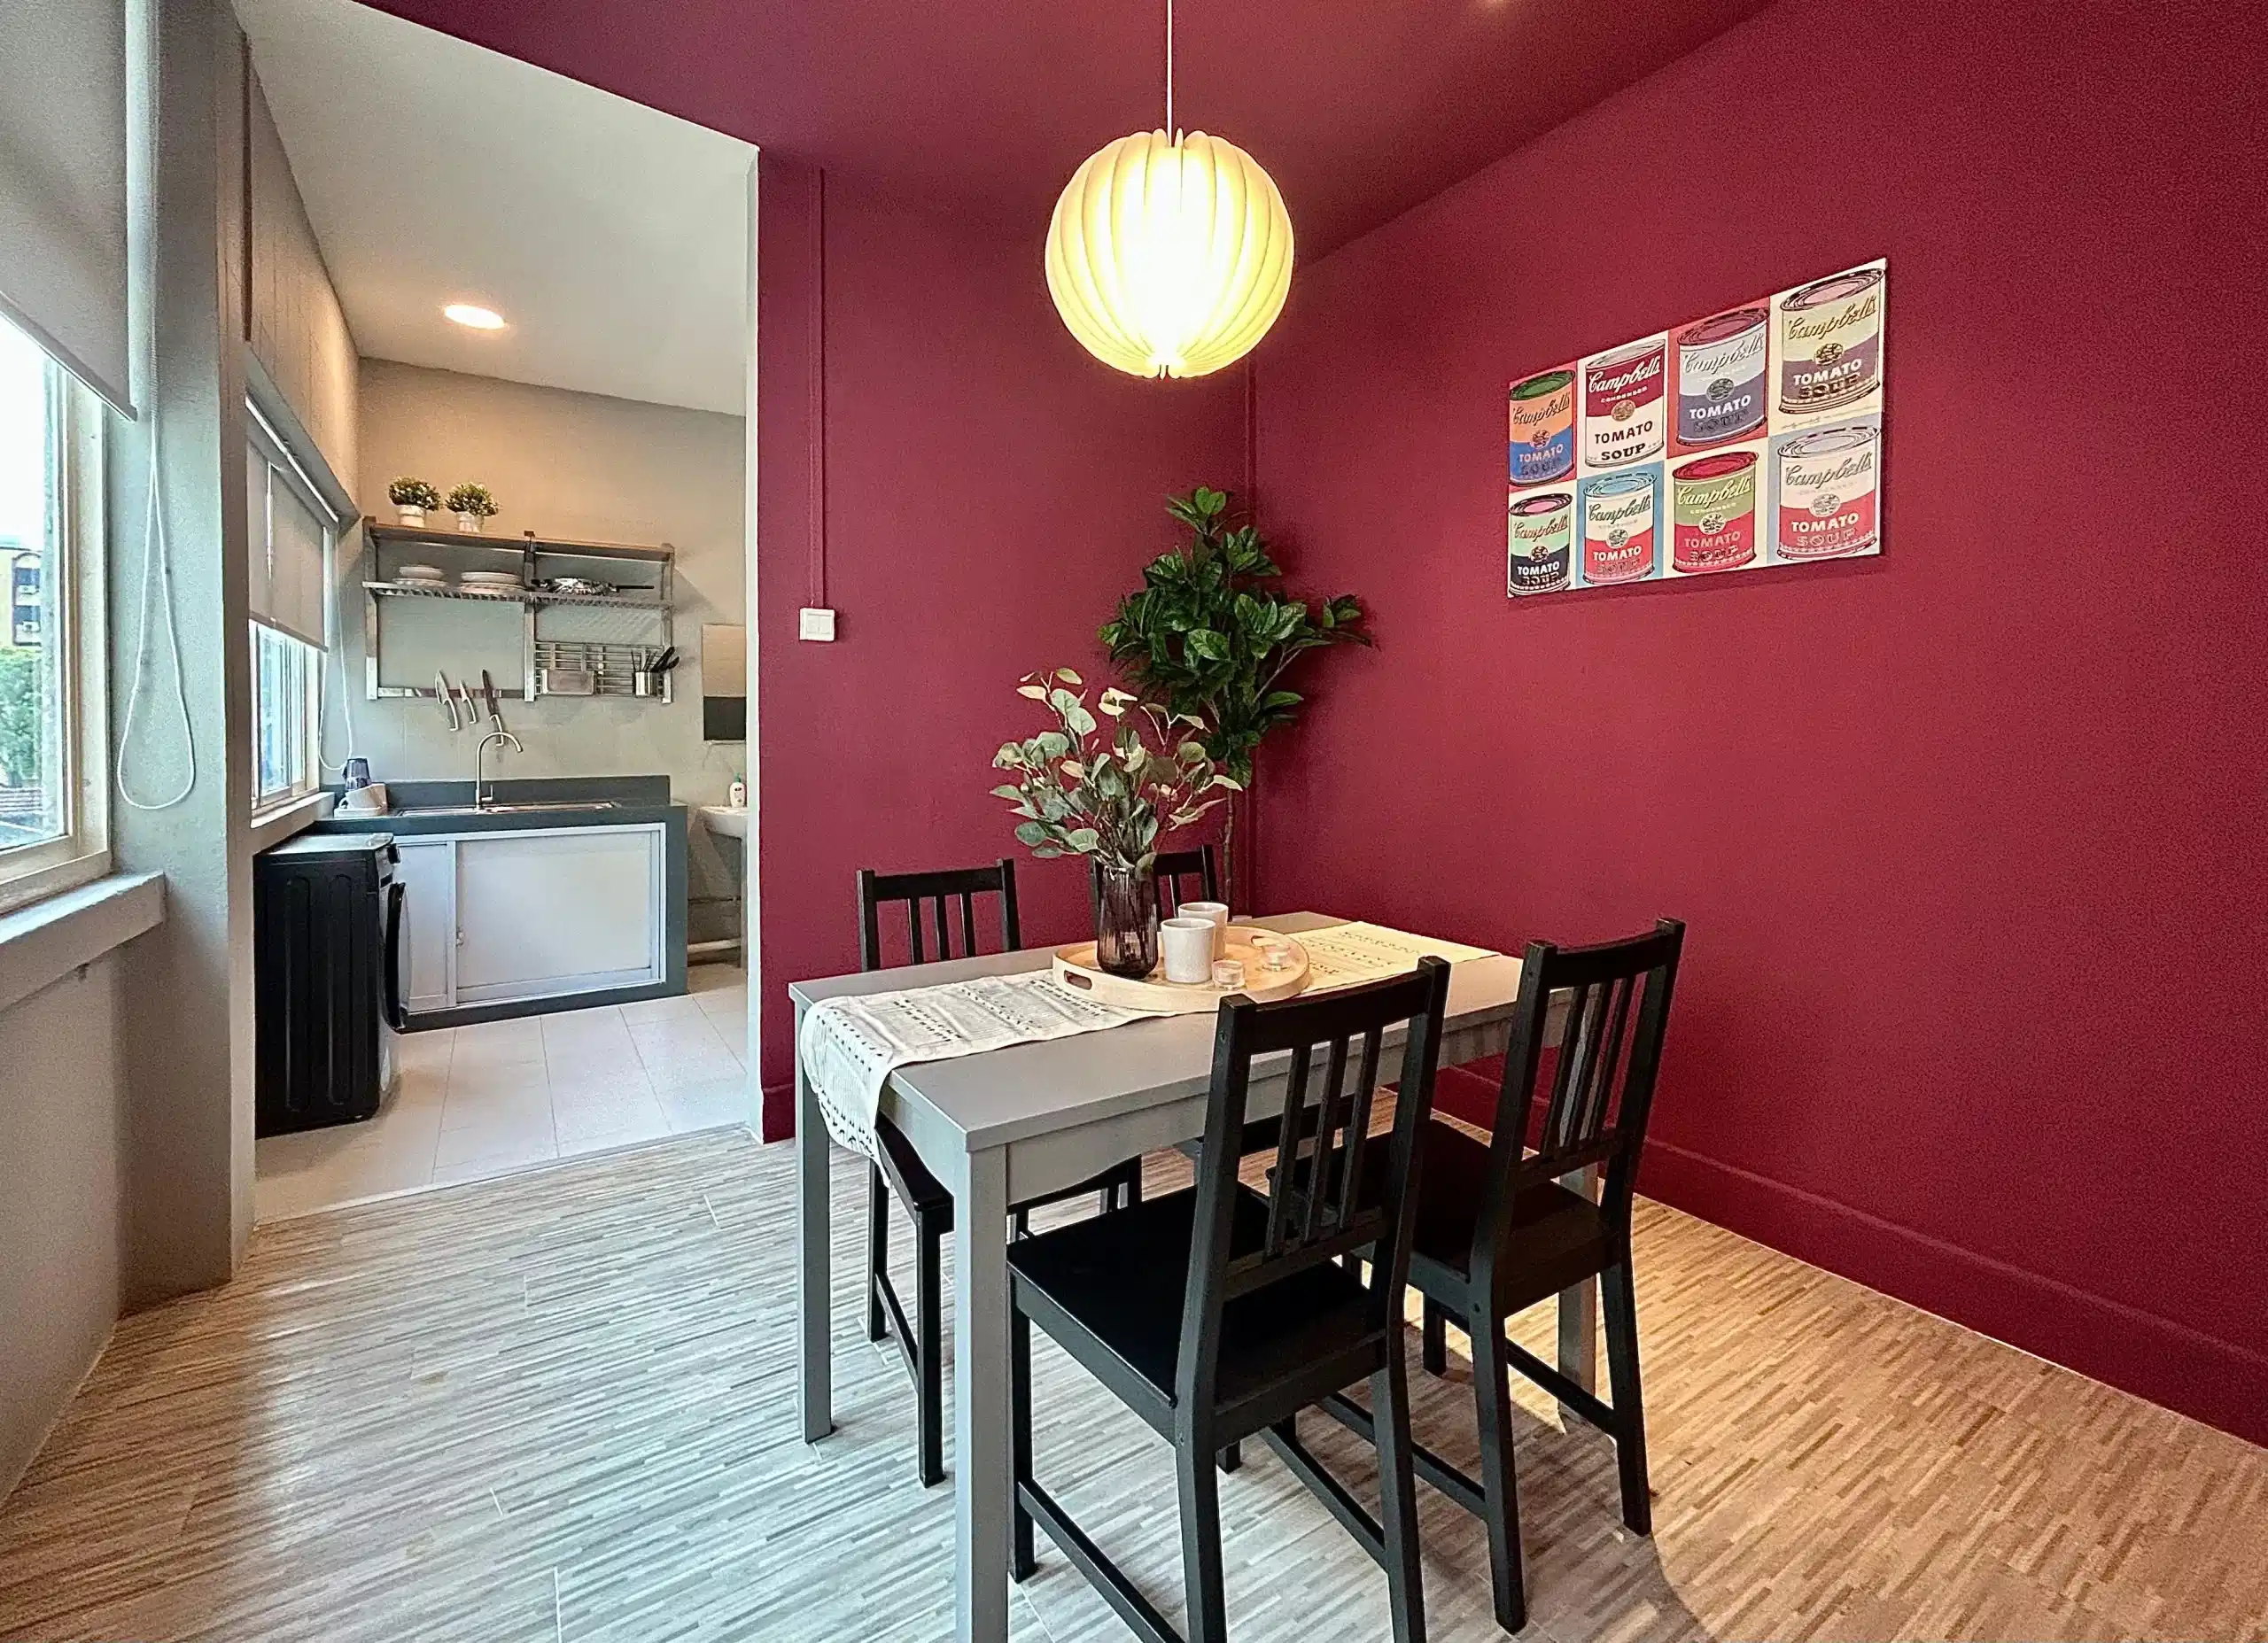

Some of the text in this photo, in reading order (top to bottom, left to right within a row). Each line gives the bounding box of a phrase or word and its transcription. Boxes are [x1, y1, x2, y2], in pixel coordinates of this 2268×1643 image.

[1793, 358, 1862, 386] TOMATO
[1689, 394, 1751, 419] TOMATO
[1595, 420, 1653, 445] TOMATO
[1518, 443, 1564, 462] TOMATO
[1601, 443, 1646, 461] SOUP
[1791, 512, 1860, 533] TOMATO
[1684, 531, 1741, 548] TOMATO
[1797, 527, 1856, 547] SOUP
[1593, 545, 1642, 562] TOMATO
[1517, 561, 1560, 576] TOMATO
